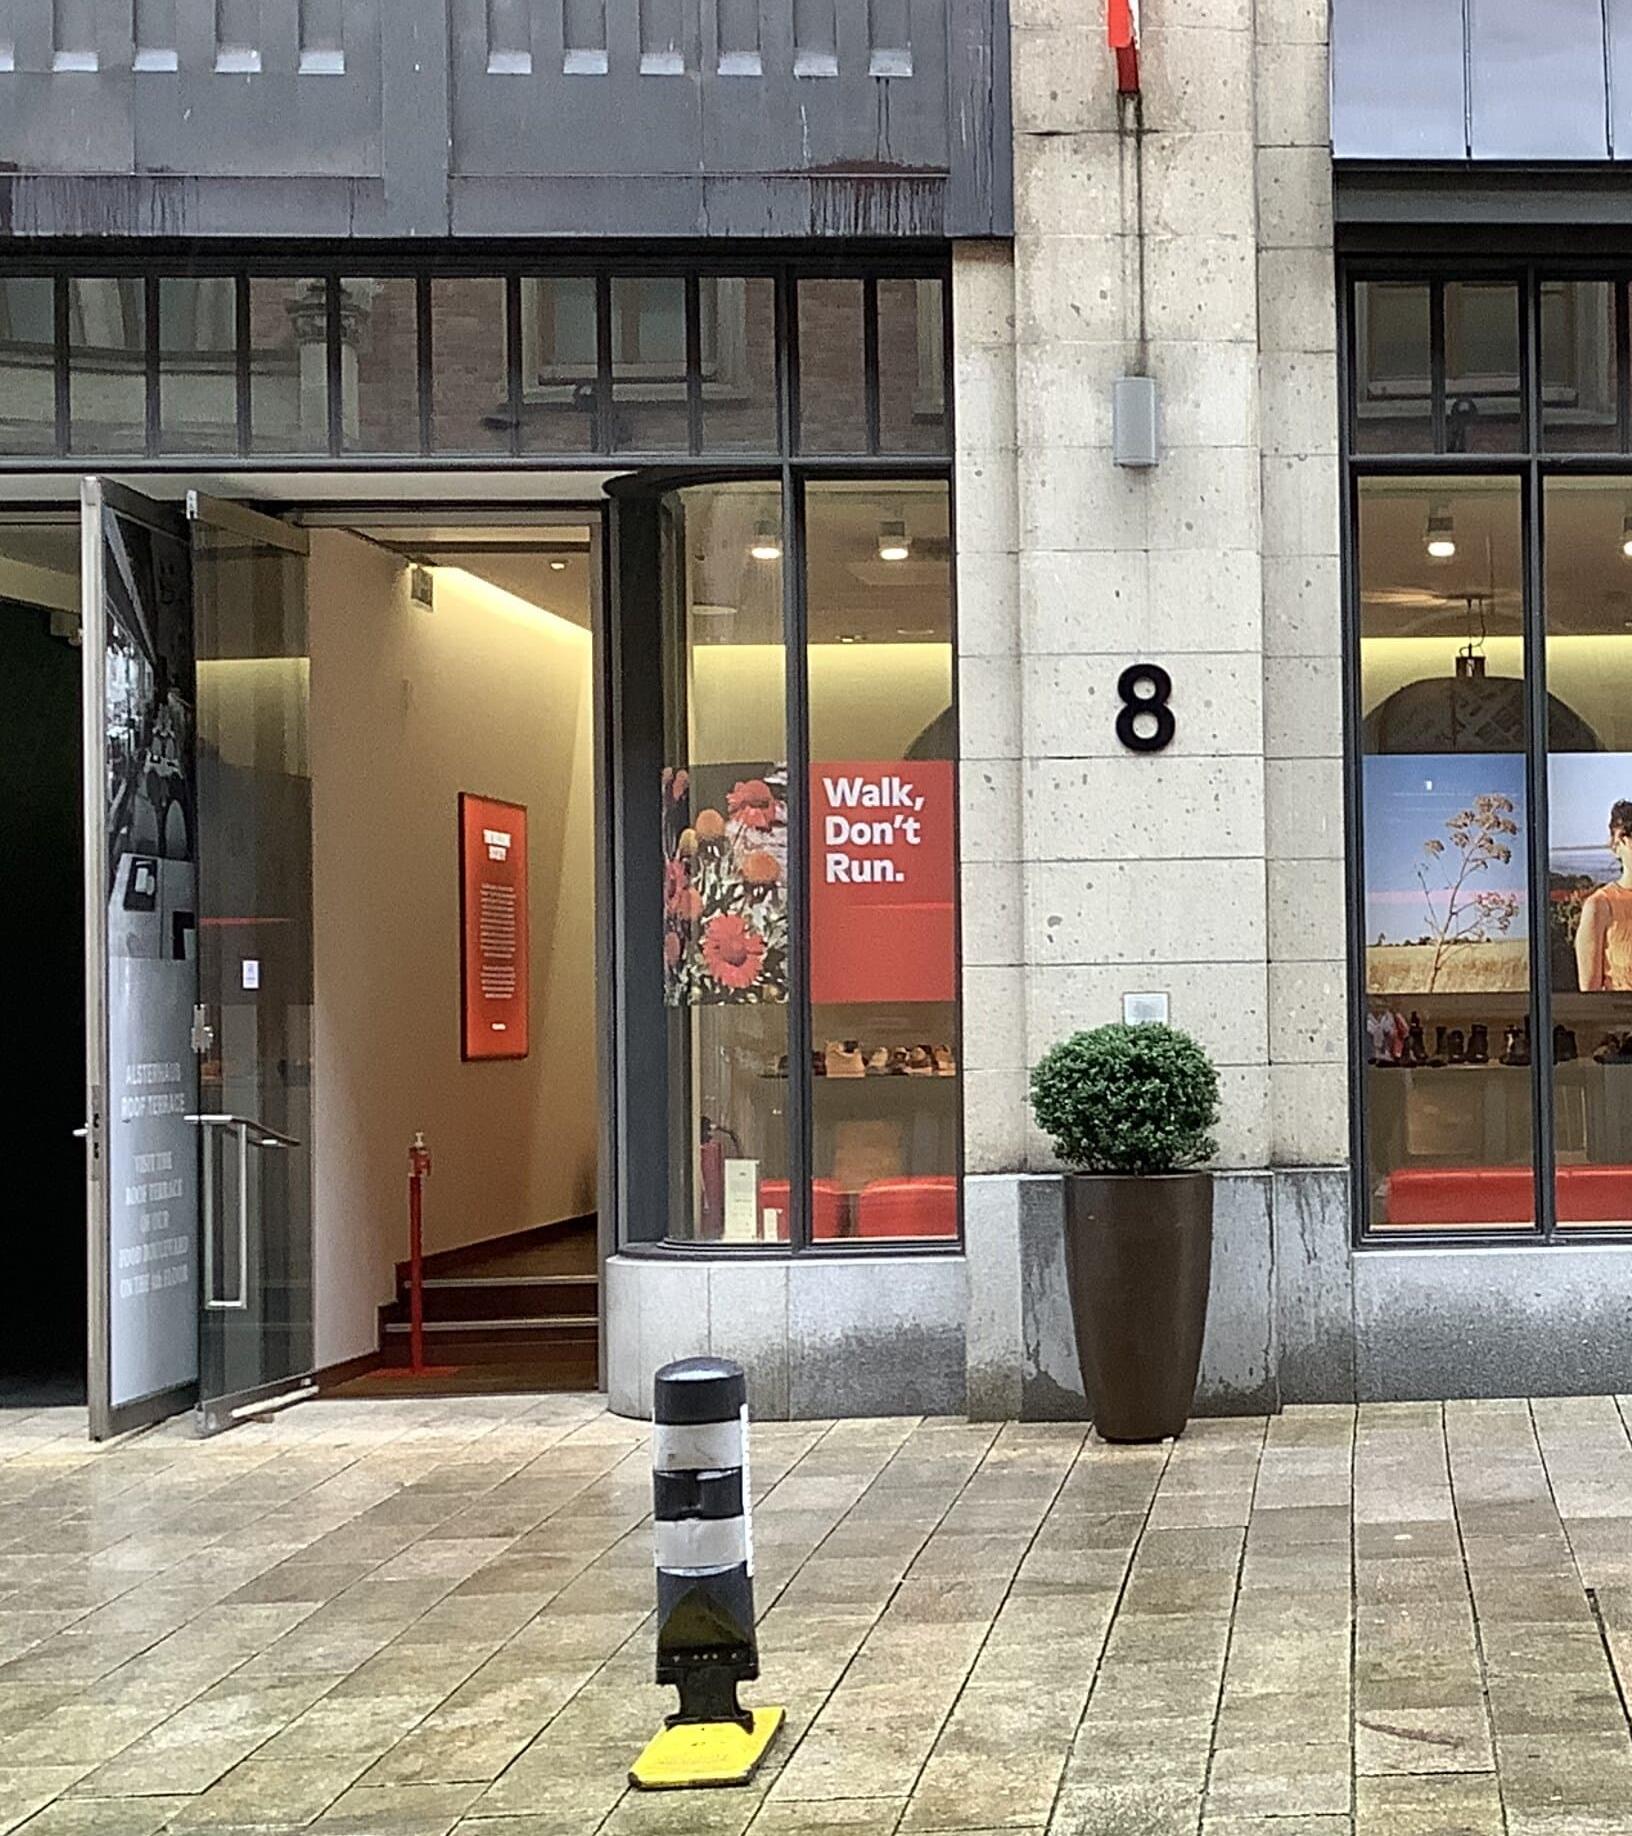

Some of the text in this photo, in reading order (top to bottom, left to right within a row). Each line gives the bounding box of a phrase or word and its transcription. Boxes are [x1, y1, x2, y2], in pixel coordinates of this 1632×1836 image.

[1115, 664, 1176, 753] 8
[822, 777, 925, 811] Walk,
[825, 814, 921, 845] Don't
[826, 852, 905, 883] Run.
